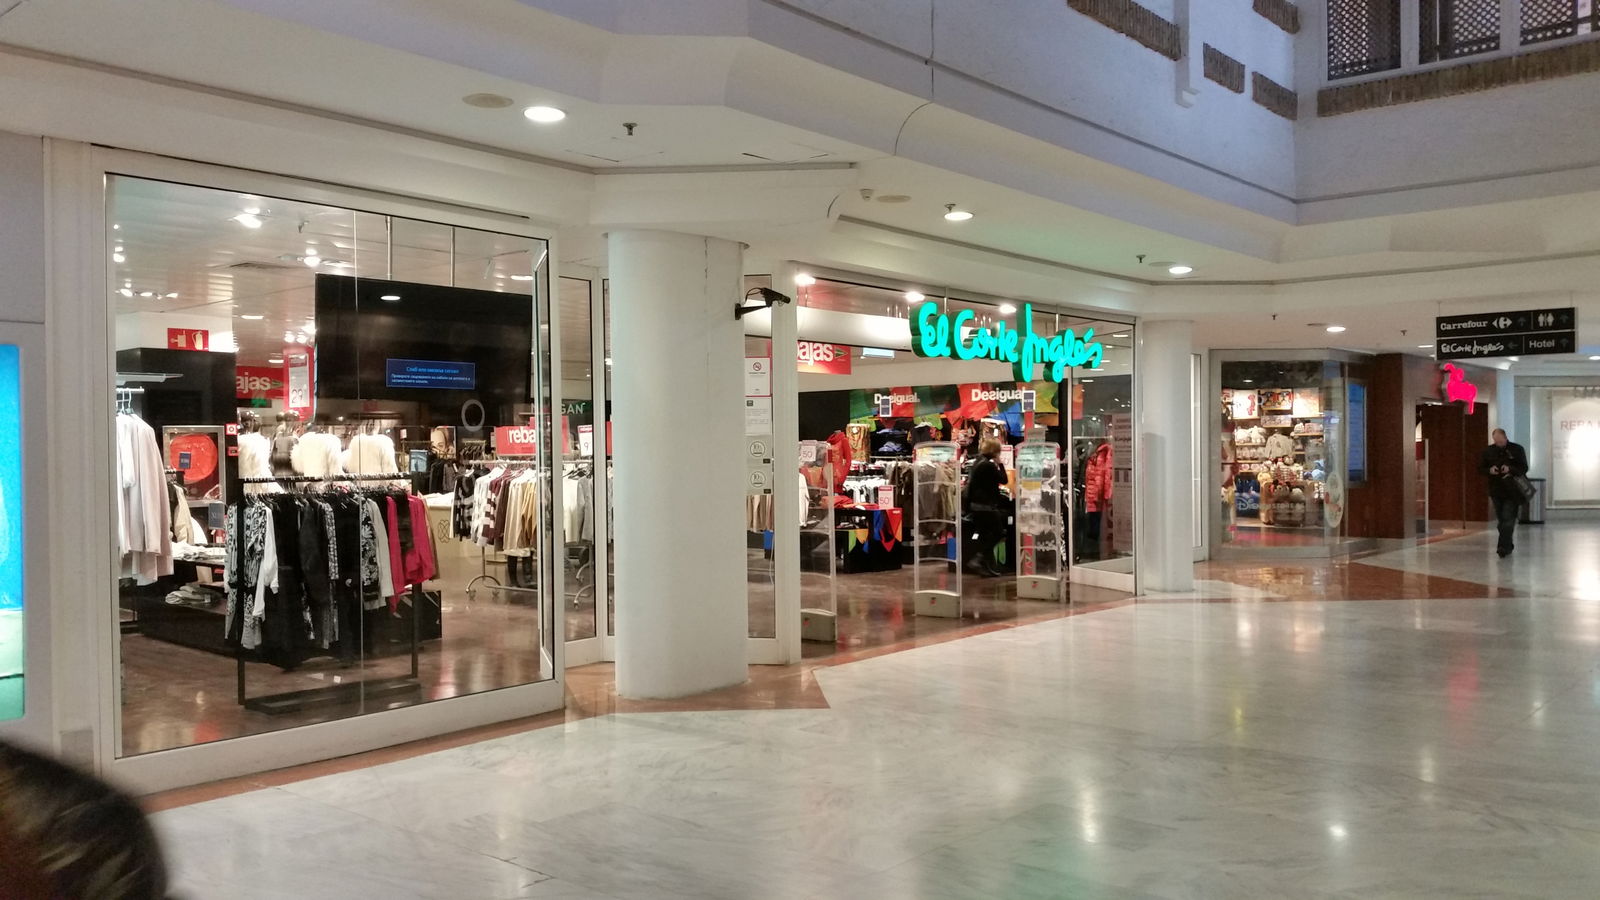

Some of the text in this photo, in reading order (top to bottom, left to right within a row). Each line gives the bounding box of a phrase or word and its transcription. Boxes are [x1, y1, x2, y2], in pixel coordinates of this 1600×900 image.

[1440, 320, 1489, 331] Carrefour
[917, 301, 1104, 383] El Corte Inglés
[1441, 343, 1451, 353] El
[1451, 342, 1472, 353] Corte
[1529, 340, 1555, 349] Hotel
[797, 341, 835, 366] ajas
[236, 372, 271, 393] ajas
[508, 426, 536, 444] reba
